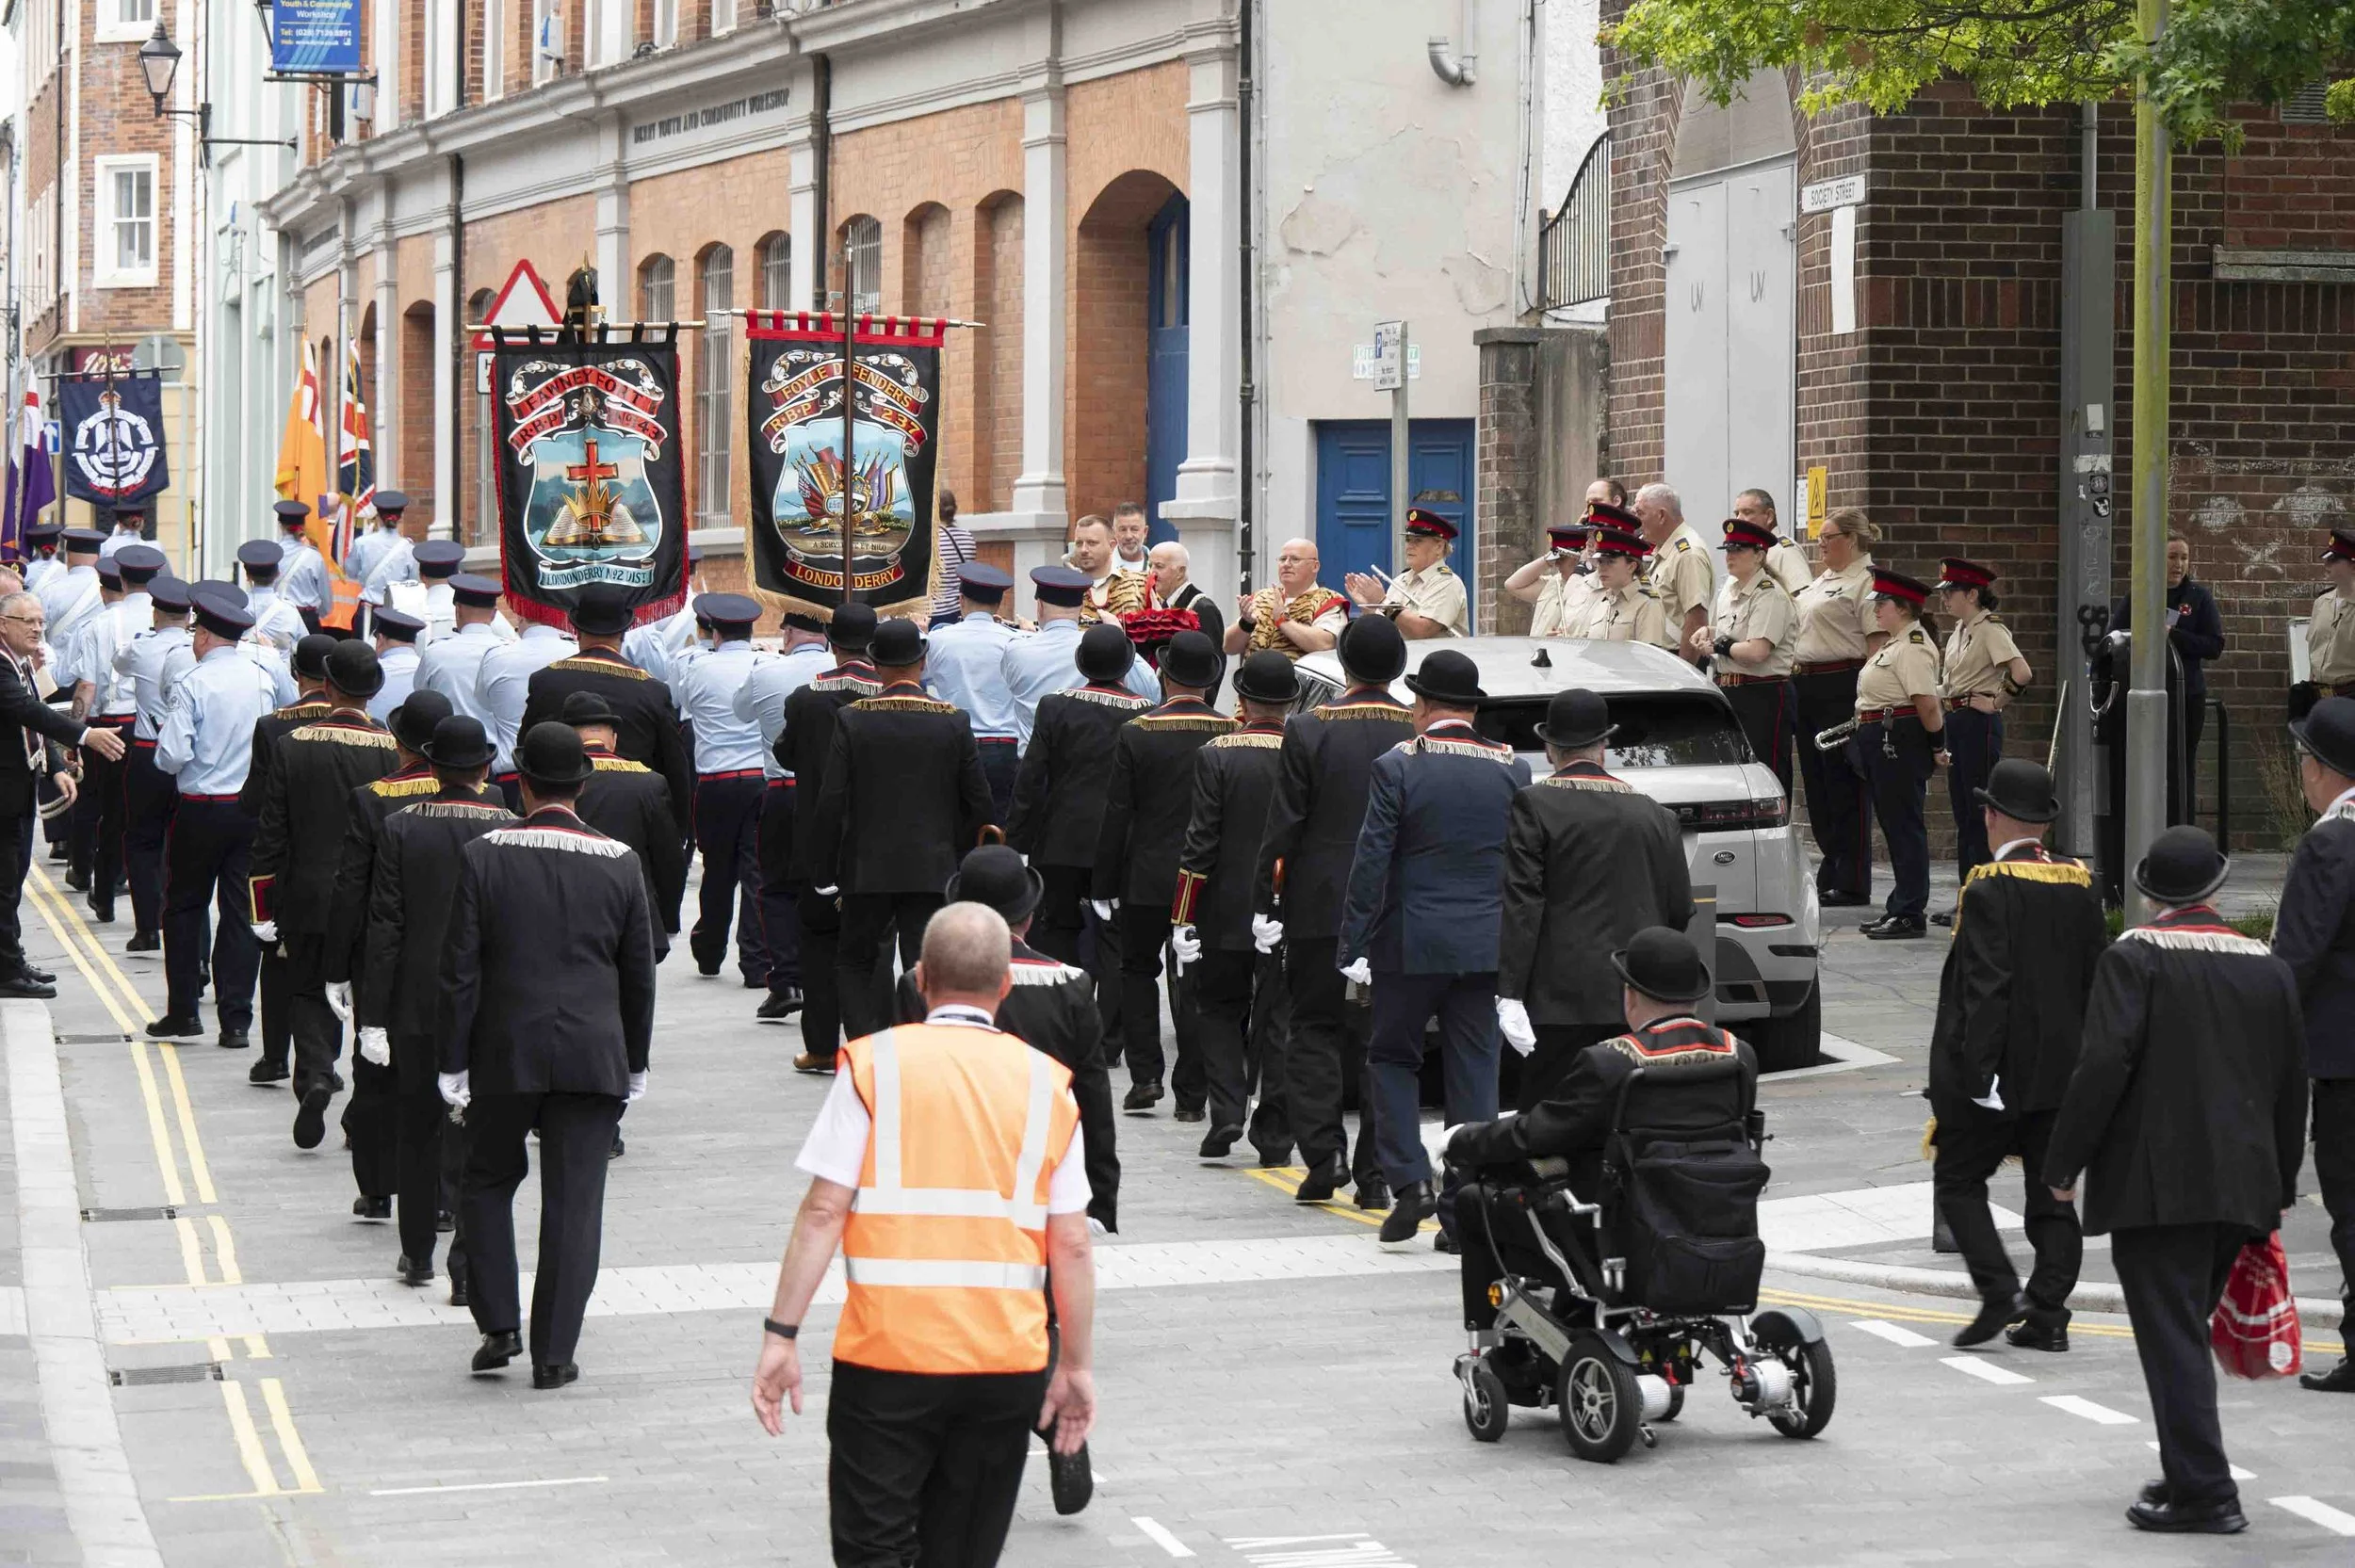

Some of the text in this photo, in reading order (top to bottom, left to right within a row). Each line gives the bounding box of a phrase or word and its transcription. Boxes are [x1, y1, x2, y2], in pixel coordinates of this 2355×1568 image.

[297, 10, 336, 19] Workshop
[310, 0, 352, 9] Community
[658, 117, 682, 137] YOUTH
[683, 111, 699, 132] AND
[701, 99, 747, 127] COMMUNITY
[749, 88, 790, 114] WORKSHOP
[1811, 182, 1856, 205] SOCIETY STREET
[527, 368, 593, 411] FAWNEY
[781, 362, 913, 409] FOYLE DFENDERS
[638, 421, 659, 440] 43
[882, 407, 921, 435] 237
[546, 567, 605, 585] LONDONDERRY
[796, 566, 895, 588] LONDODERRY
